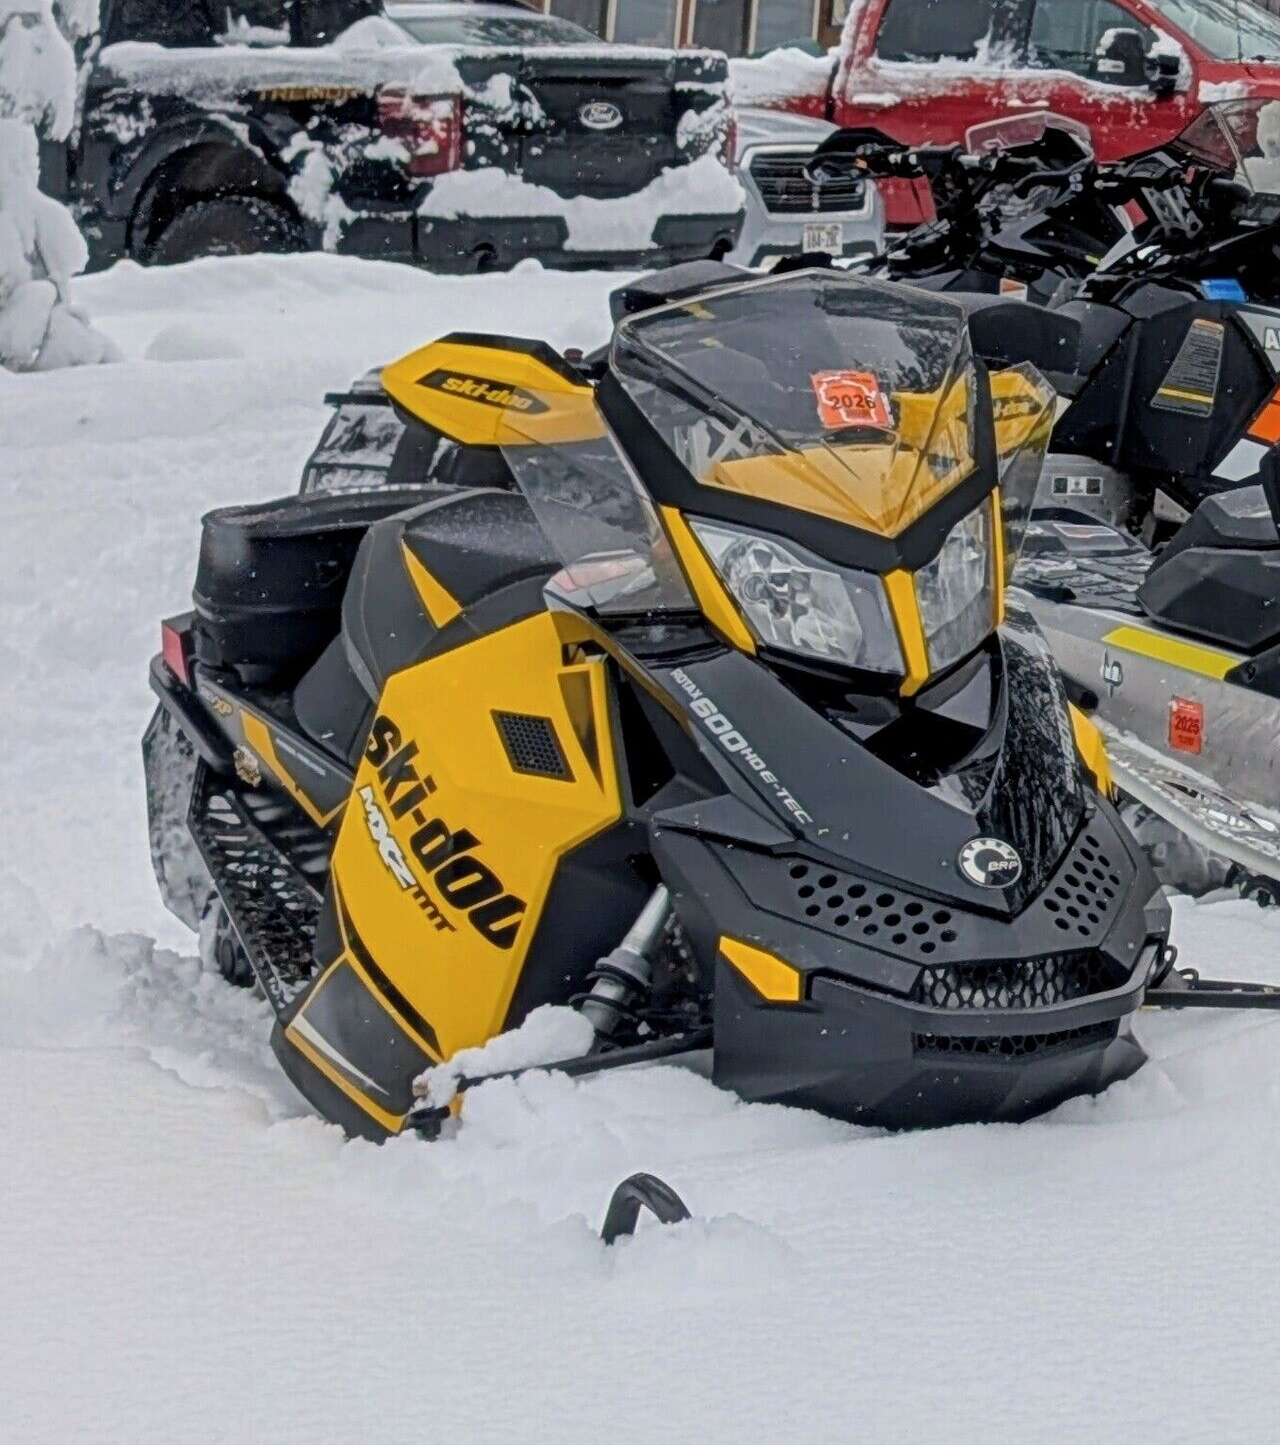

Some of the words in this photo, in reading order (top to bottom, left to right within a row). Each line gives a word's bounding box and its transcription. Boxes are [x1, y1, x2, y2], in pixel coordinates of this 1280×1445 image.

[441, 377, 534, 410] ski-doo
[828, 394, 877, 411] 2026
[670, 667, 703, 700] ROTAX
[690, 697, 749, 753] 600
[759, 770, 814, 825] E-TEC
[365, 714, 528, 950] ski-doo
